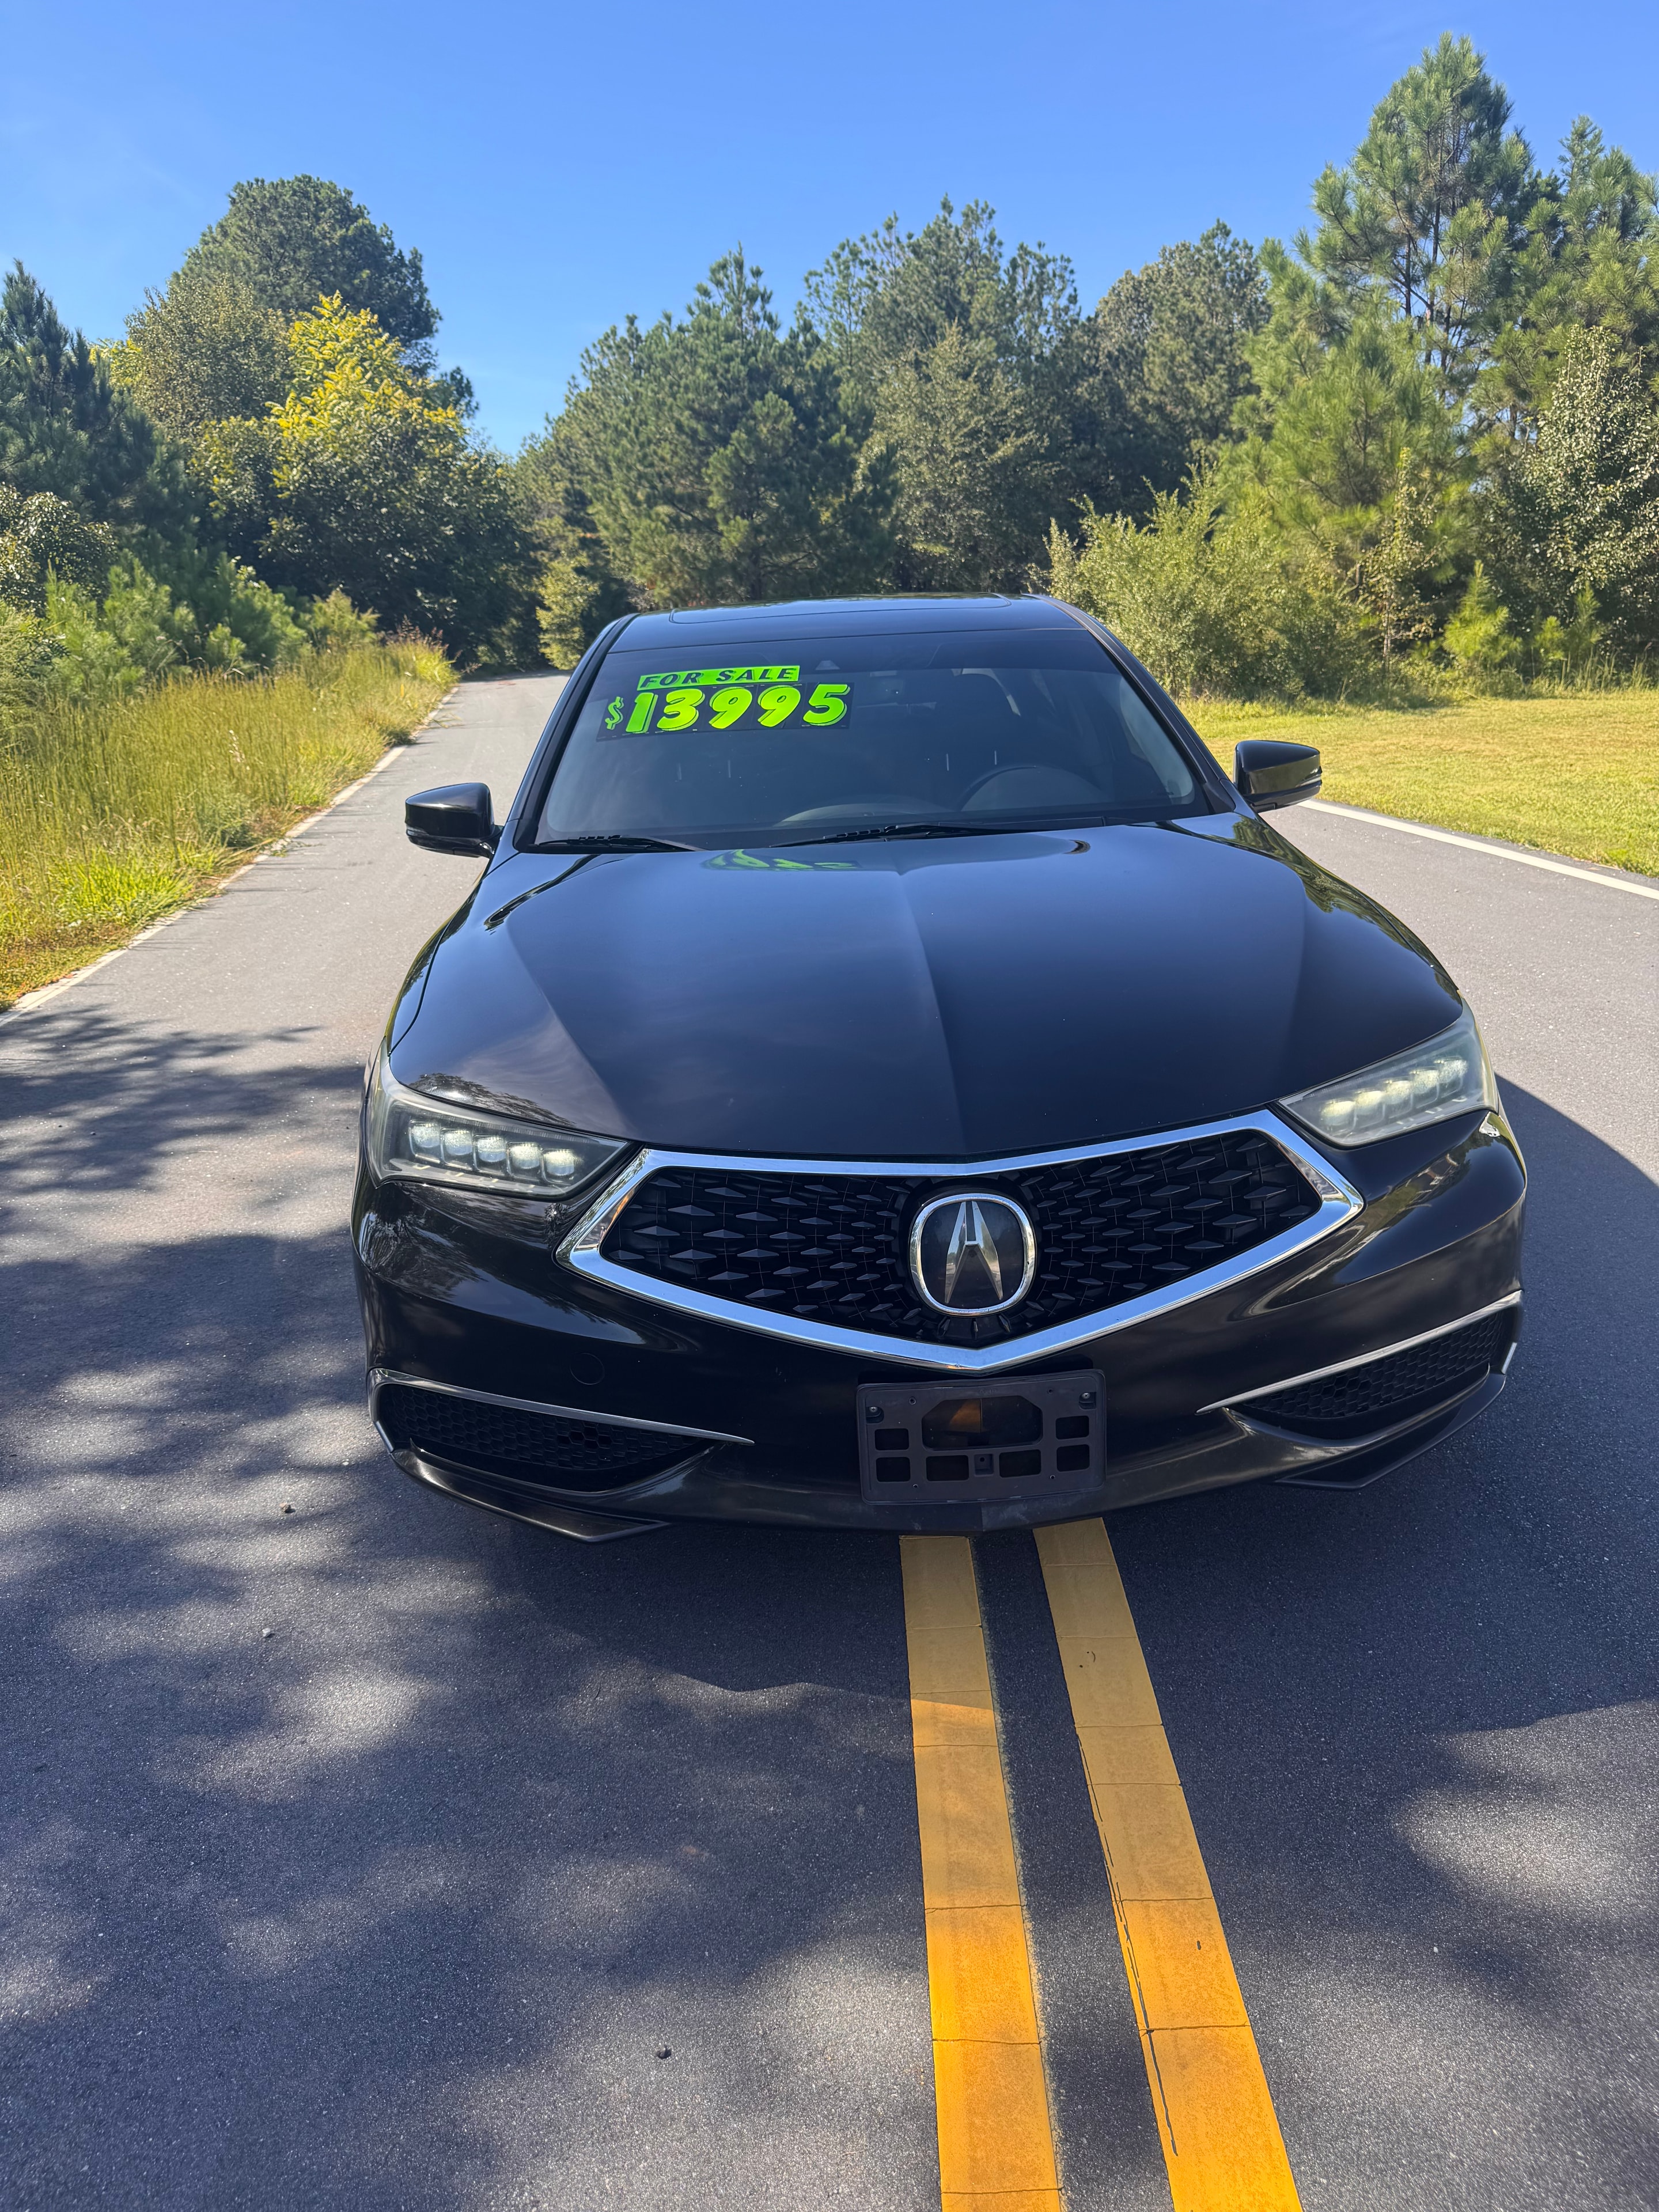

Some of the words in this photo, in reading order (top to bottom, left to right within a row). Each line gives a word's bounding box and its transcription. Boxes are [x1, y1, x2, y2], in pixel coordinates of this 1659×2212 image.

[640, 672, 704, 688] FOR
[715, 668, 797, 683] SALE
[605, 684, 851, 734] $13995
